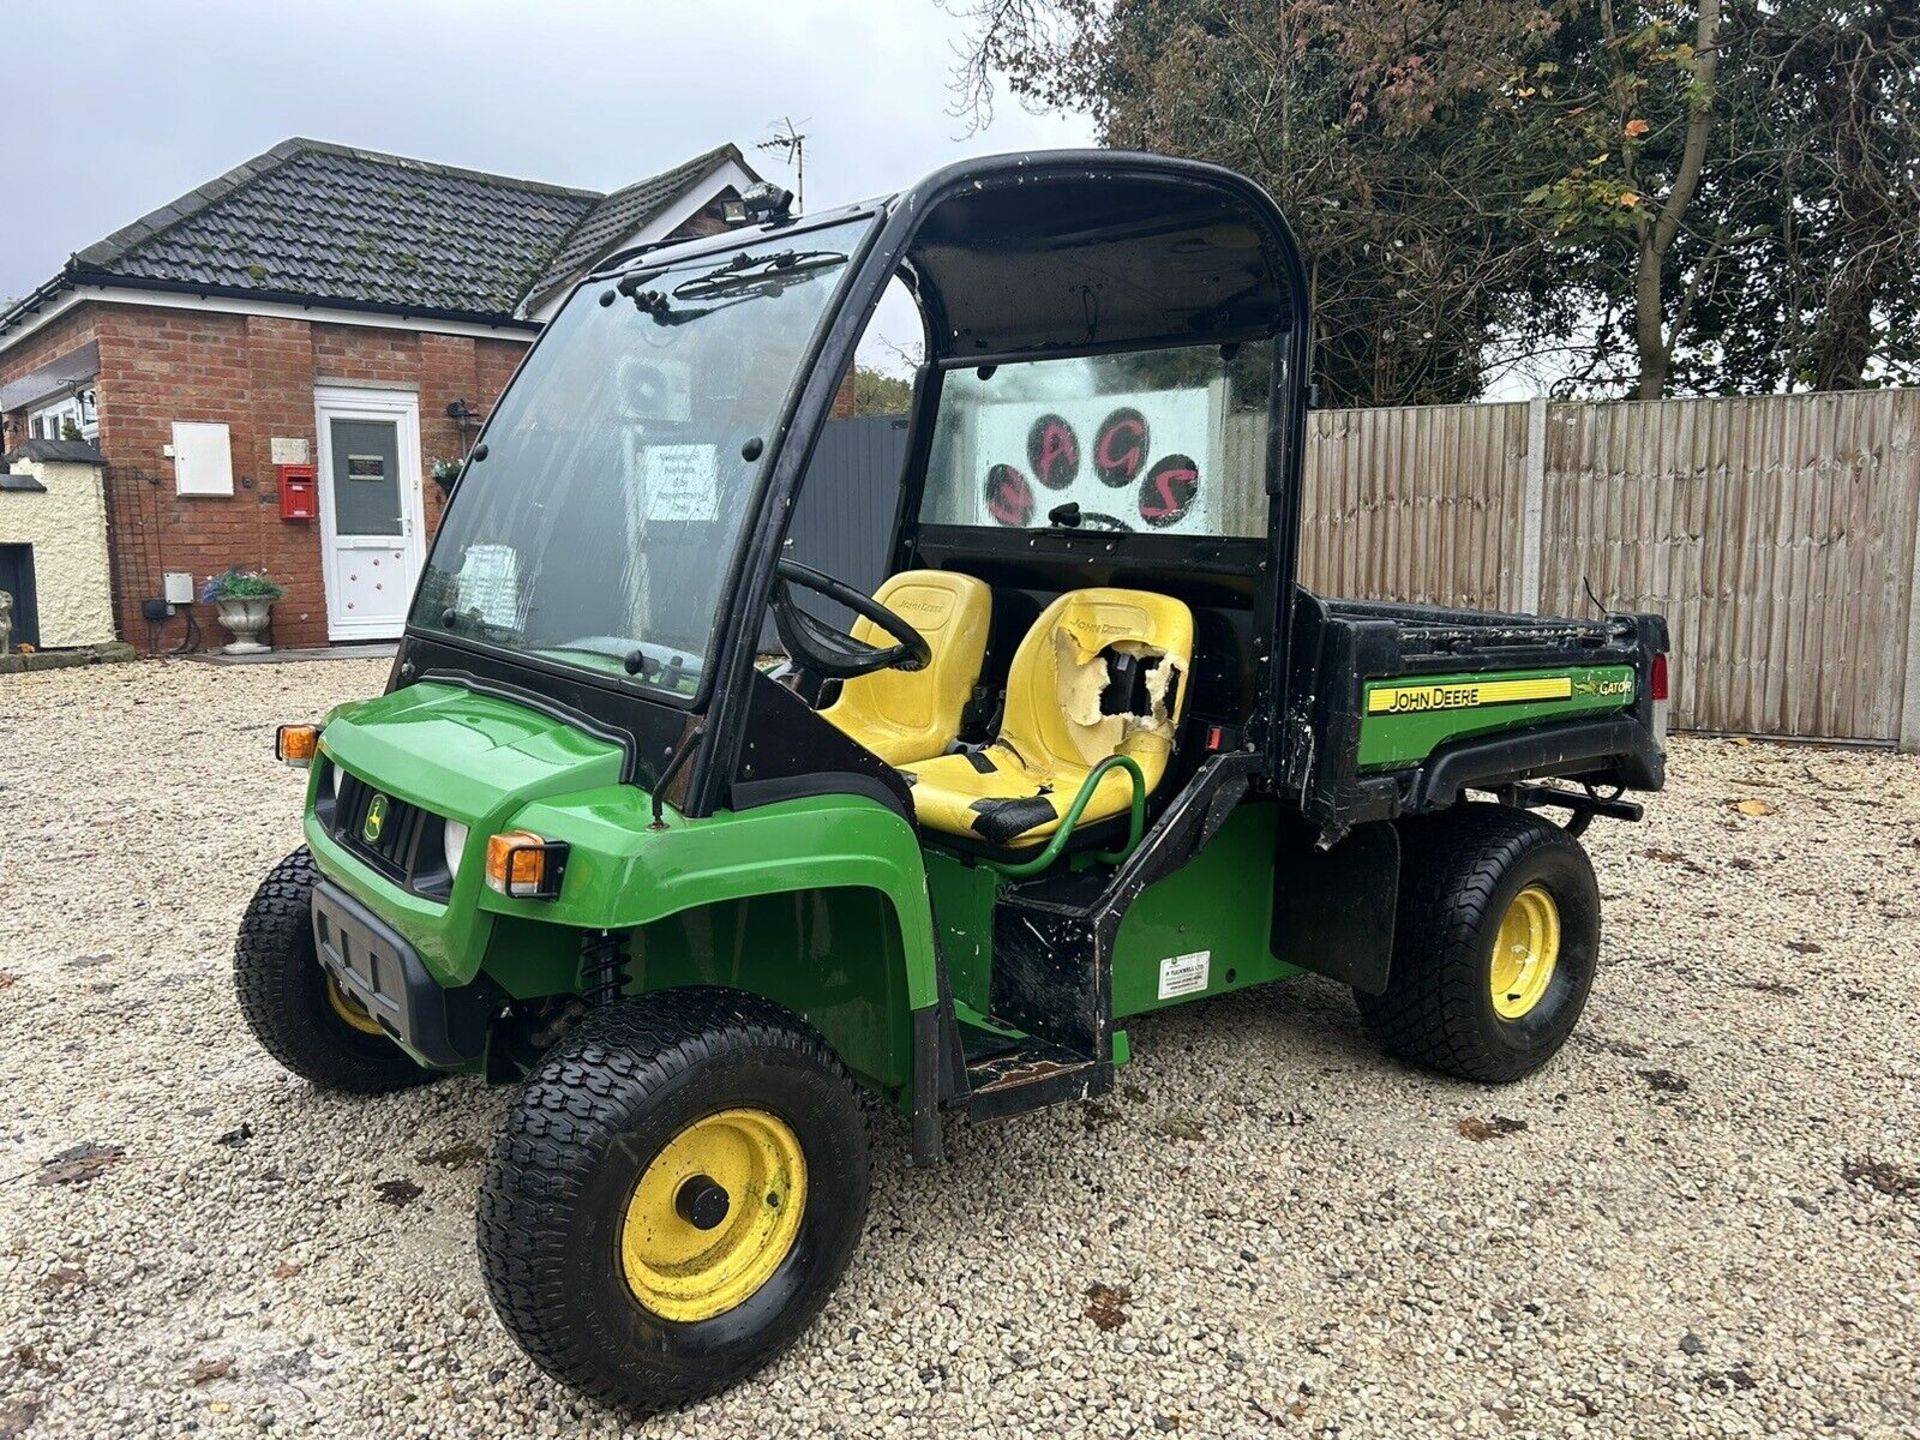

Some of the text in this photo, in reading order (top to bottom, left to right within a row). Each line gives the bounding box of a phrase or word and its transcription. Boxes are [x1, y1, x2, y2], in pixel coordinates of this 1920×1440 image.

[1070, 618, 1102, 633] JOHN
[1389, 679, 1632, 711] JOHN DEERE GATOR
